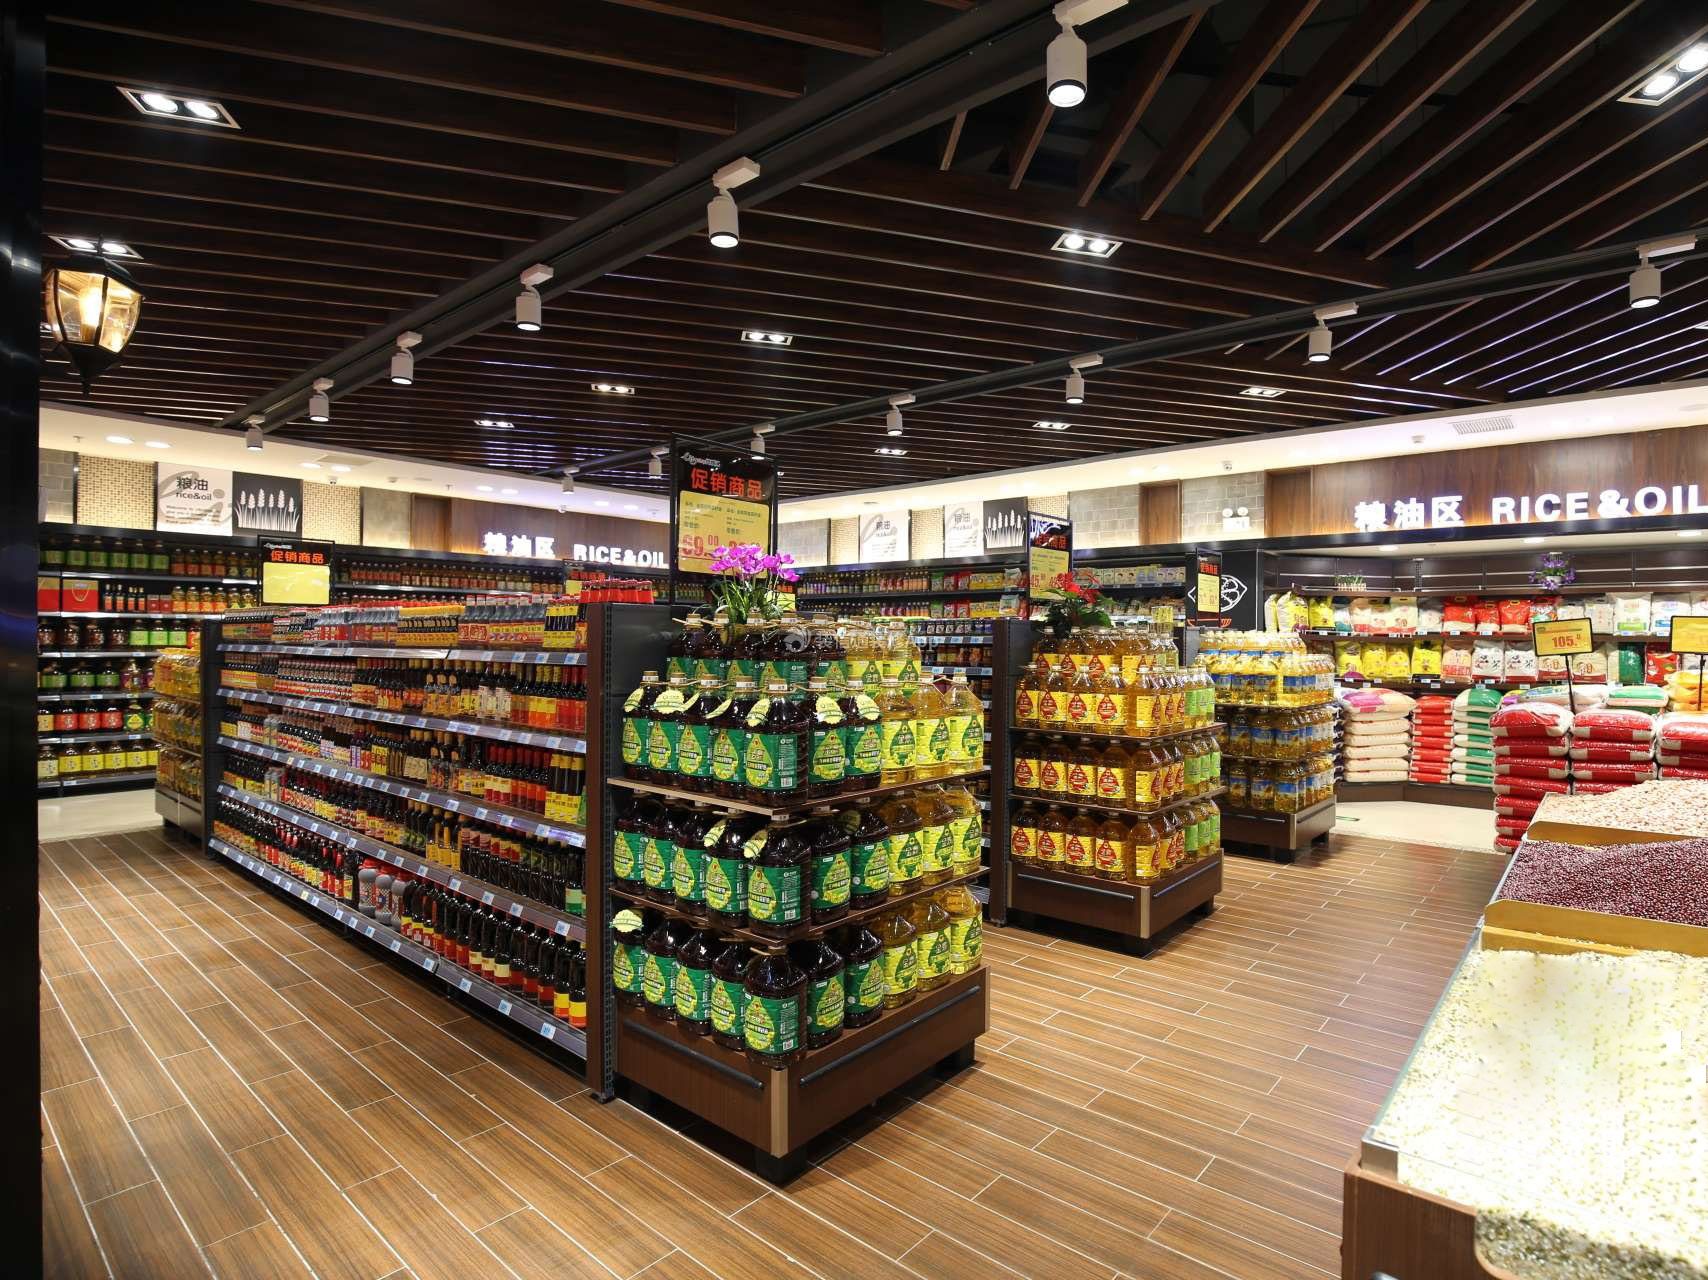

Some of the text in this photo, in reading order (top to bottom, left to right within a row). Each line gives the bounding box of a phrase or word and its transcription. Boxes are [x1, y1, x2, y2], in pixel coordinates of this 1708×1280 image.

[176, 476, 209, 491] 粮油
[690, 467, 763, 500] 促销商品
[175, 491, 212, 502] rice&oil
[1353, 495, 1465, 532] 粮油区
[271, 550, 325, 565] 促销商品
